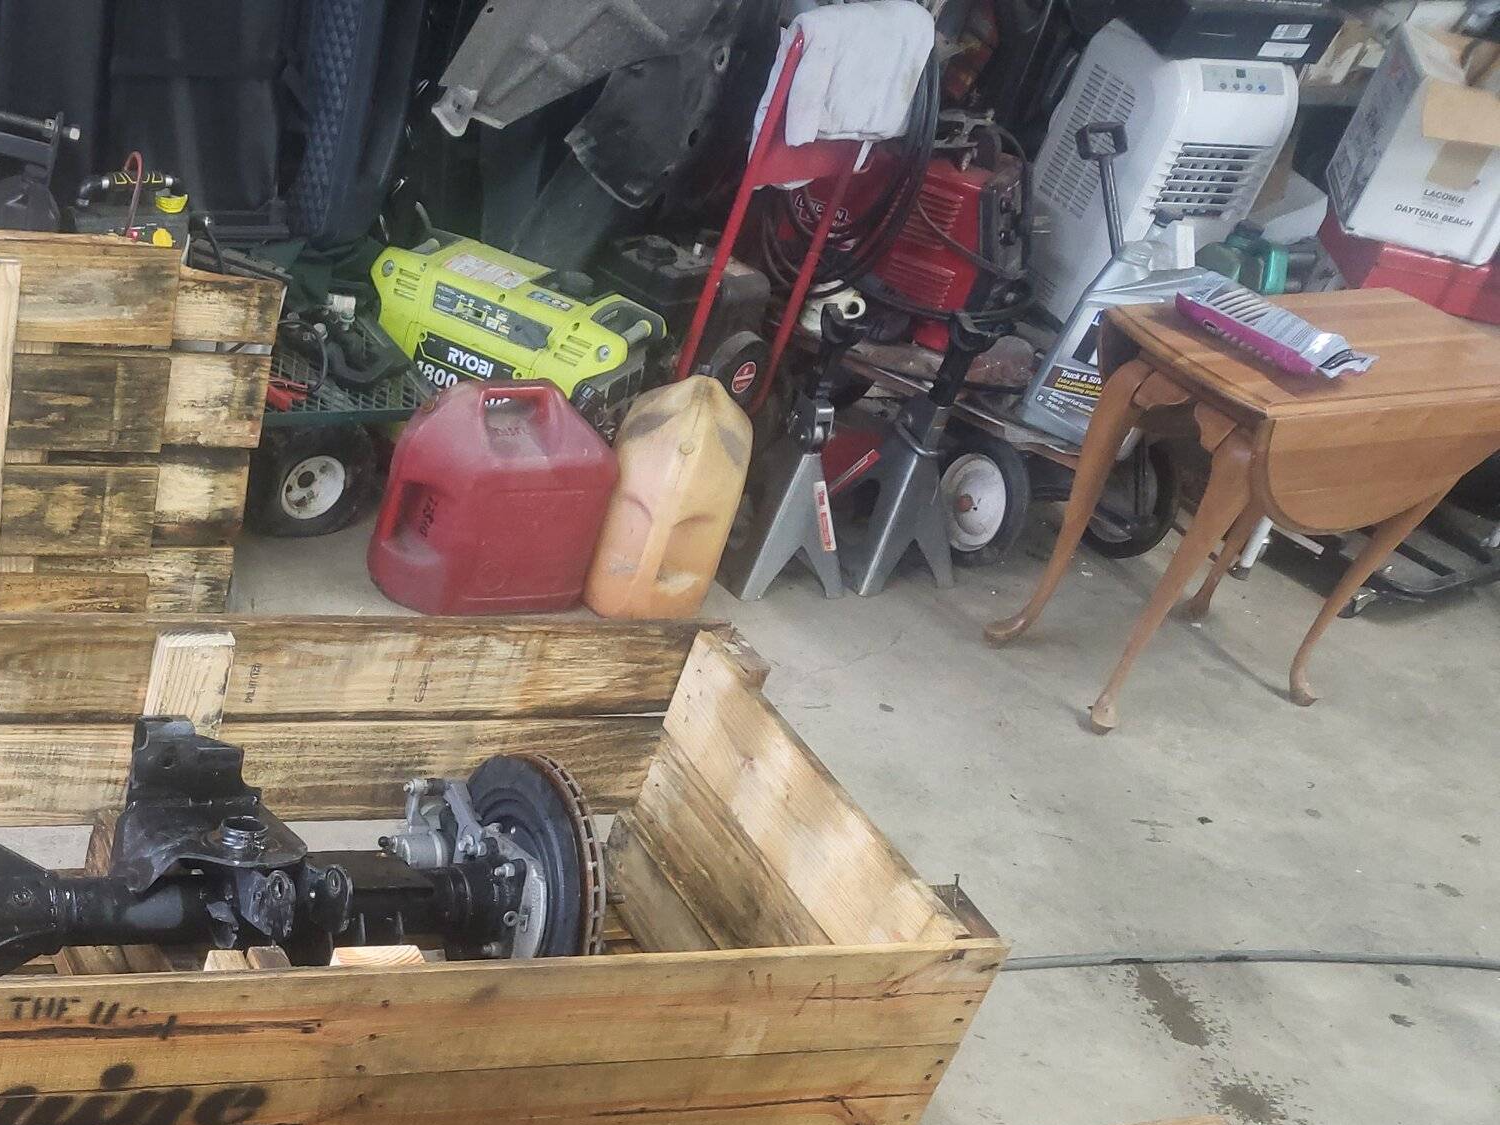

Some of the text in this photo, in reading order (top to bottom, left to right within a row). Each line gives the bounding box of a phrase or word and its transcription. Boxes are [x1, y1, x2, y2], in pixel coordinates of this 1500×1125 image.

[1423, 188, 1465, 204] LACONIA
[1394, 203, 1474, 227] DAYTONA BEACH
[447, 346, 494, 378] RYOBI
[1061, 369, 1081, 380] Truck
[1081, 374, 1088, 382] &
[10, 996, 80, 1021] THE
